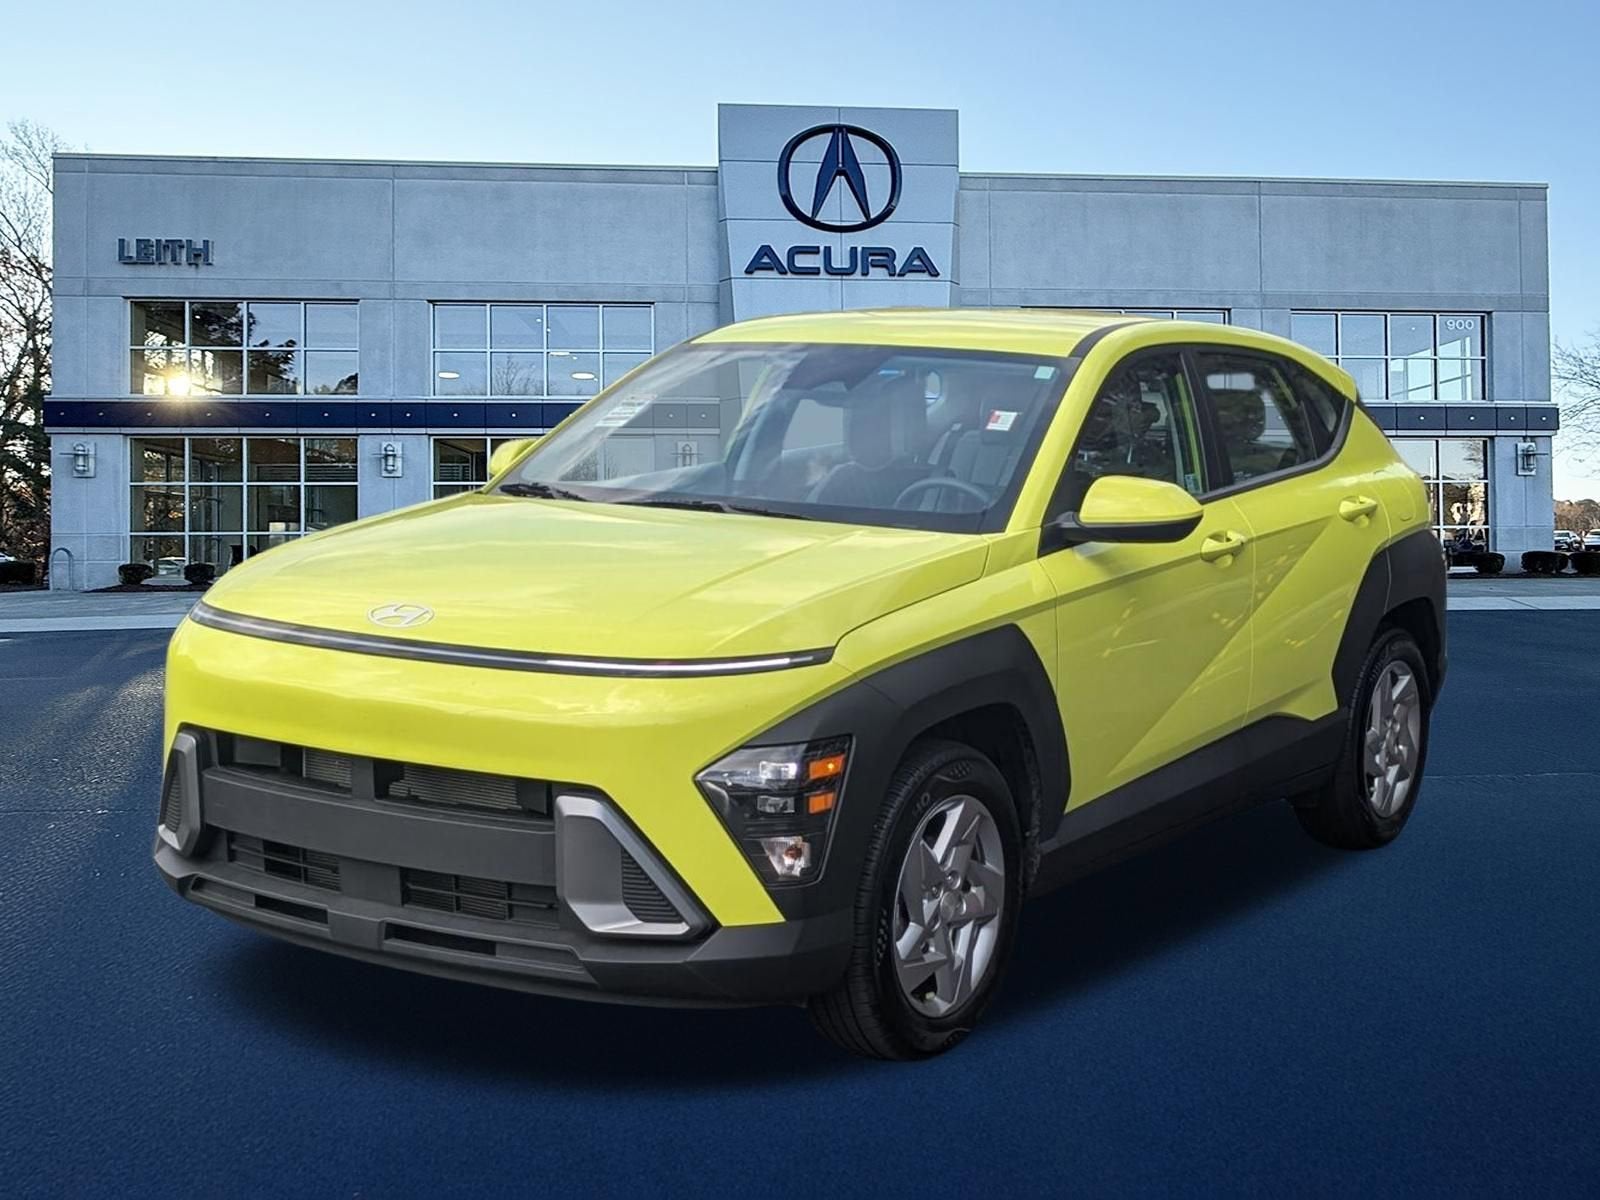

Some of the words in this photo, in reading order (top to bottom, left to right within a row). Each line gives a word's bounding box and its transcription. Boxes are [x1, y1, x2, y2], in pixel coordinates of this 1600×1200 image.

[118, 238, 210, 263] LEITH
[744, 245, 940, 277] ACURA
[1446, 319, 1475, 330] 900
